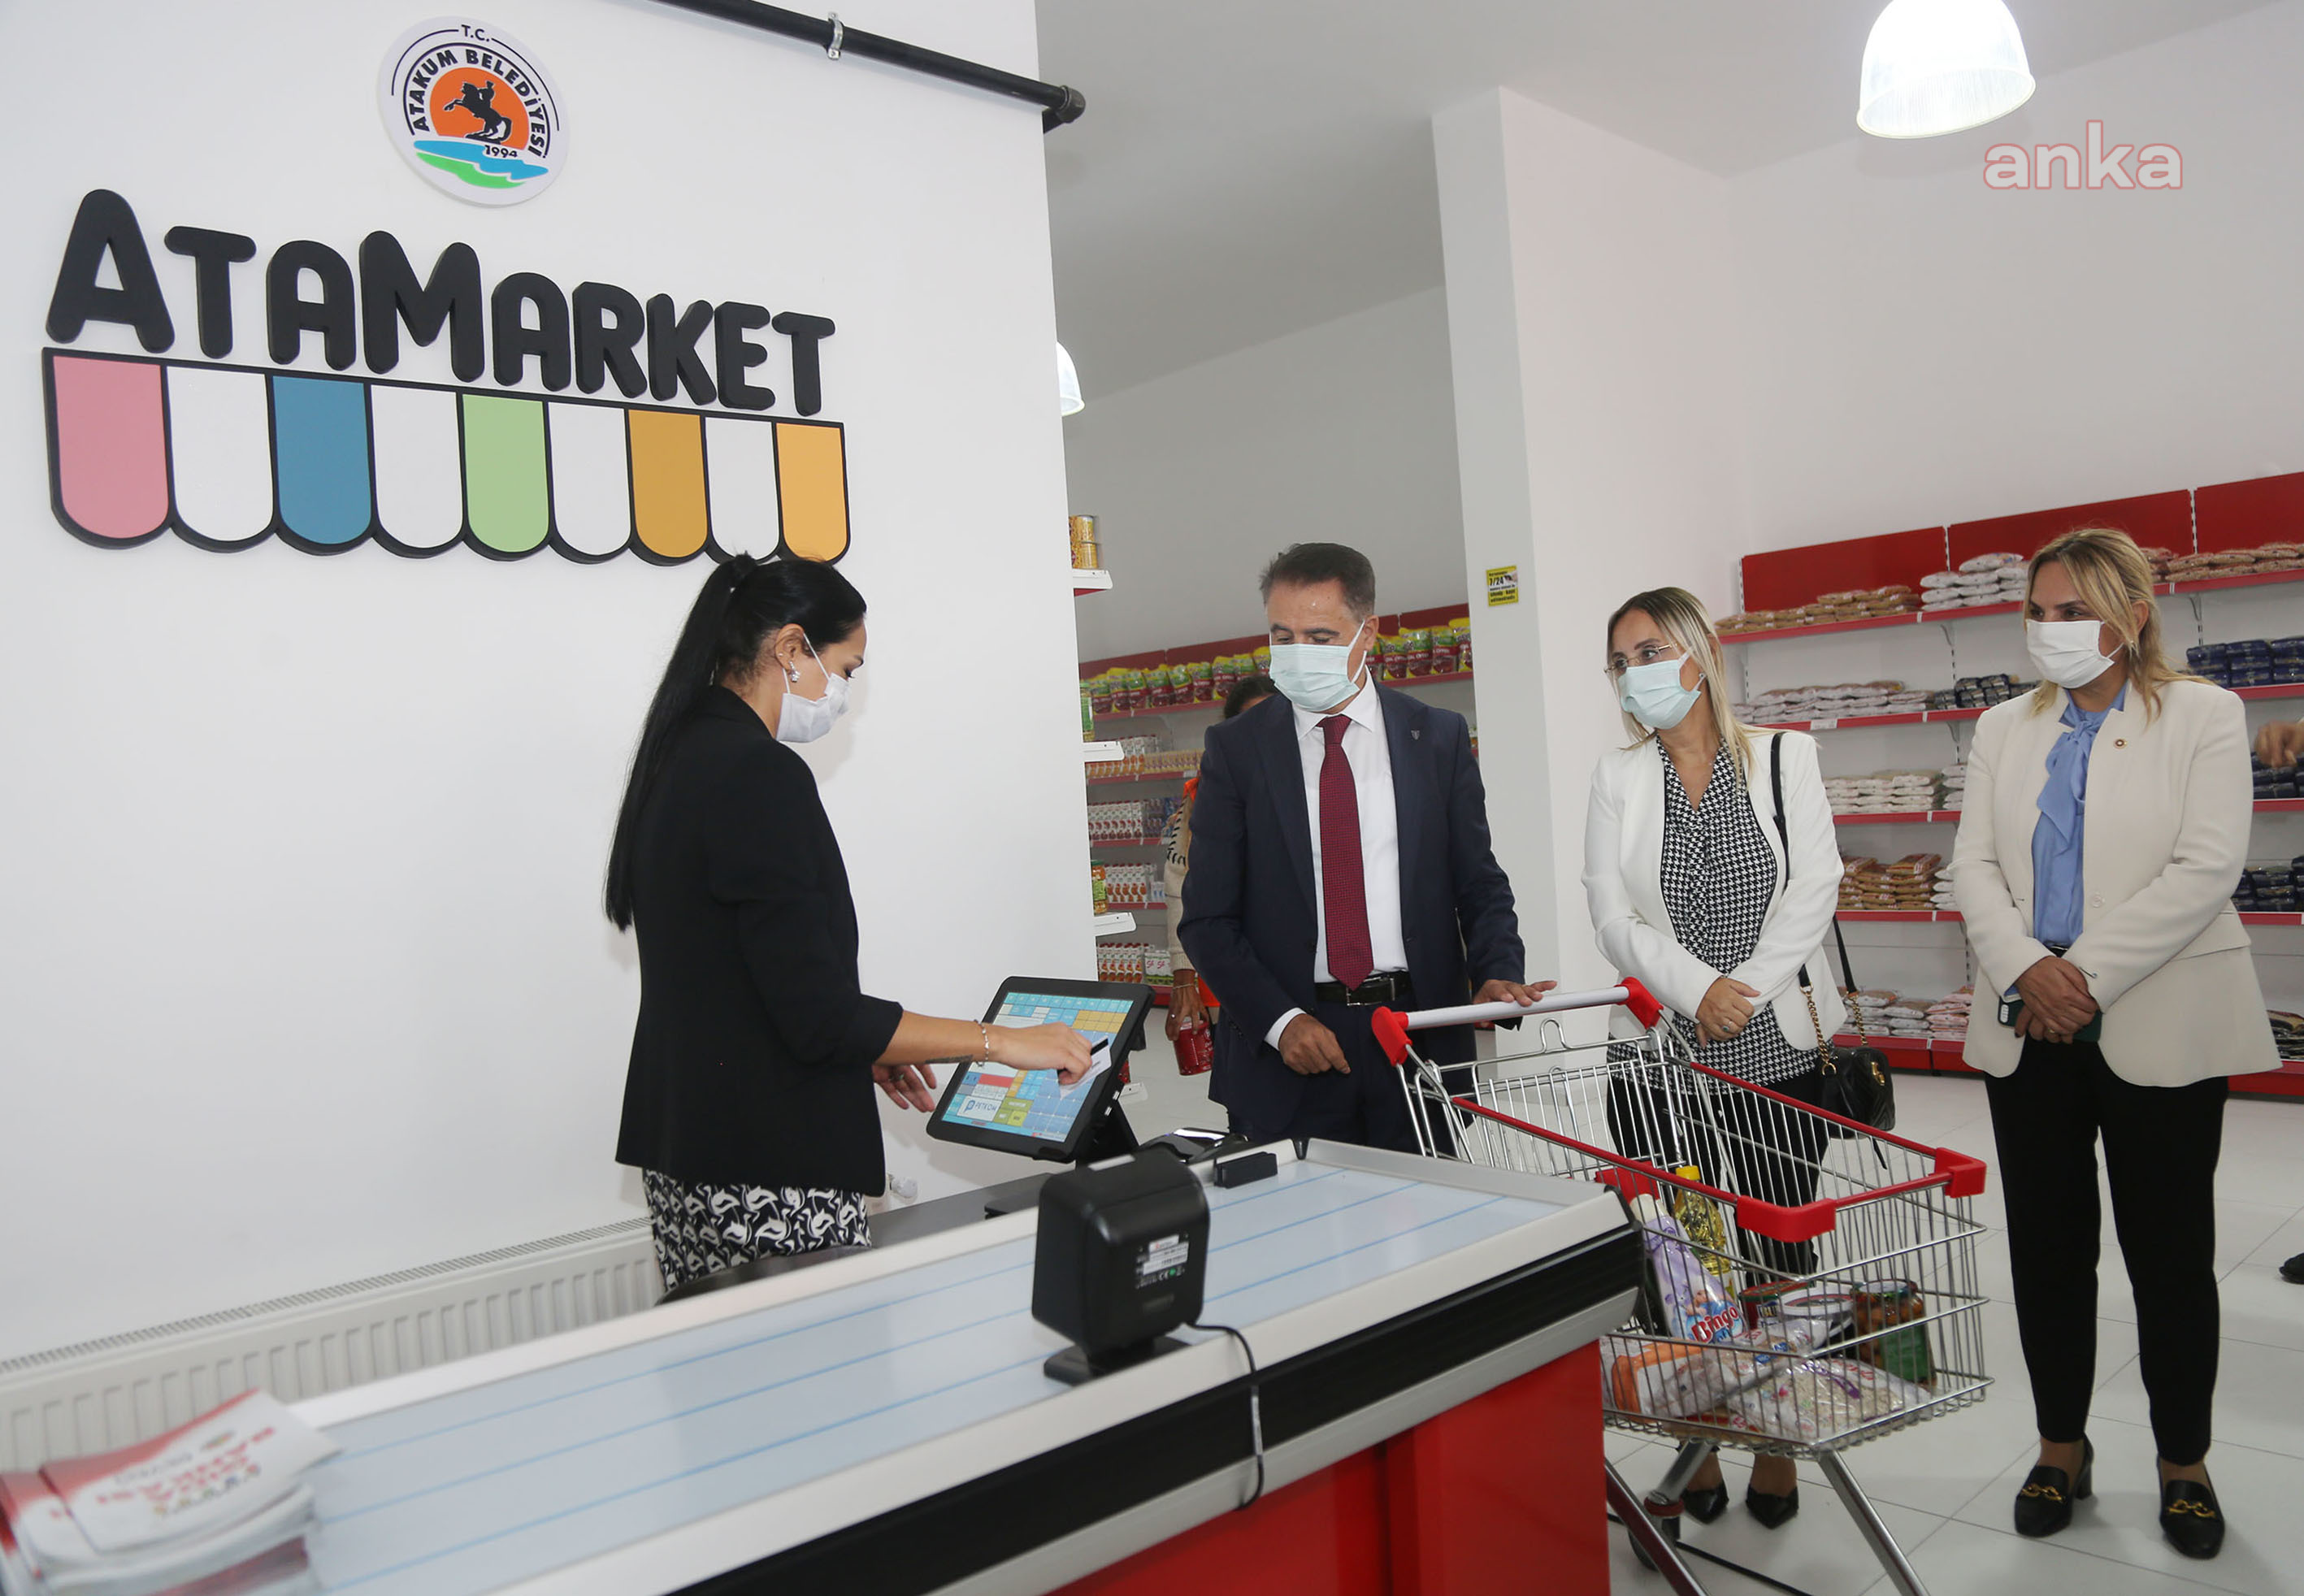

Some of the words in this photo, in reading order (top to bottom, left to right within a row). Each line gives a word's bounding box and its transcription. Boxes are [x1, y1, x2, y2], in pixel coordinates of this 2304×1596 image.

[461, 24, 489, 41] T.C.
[409, 50, 458, 132] ATAKUM
[484, 145, 518, 158] 1994
[1690, 1306, 1740, 1344] Bingo
